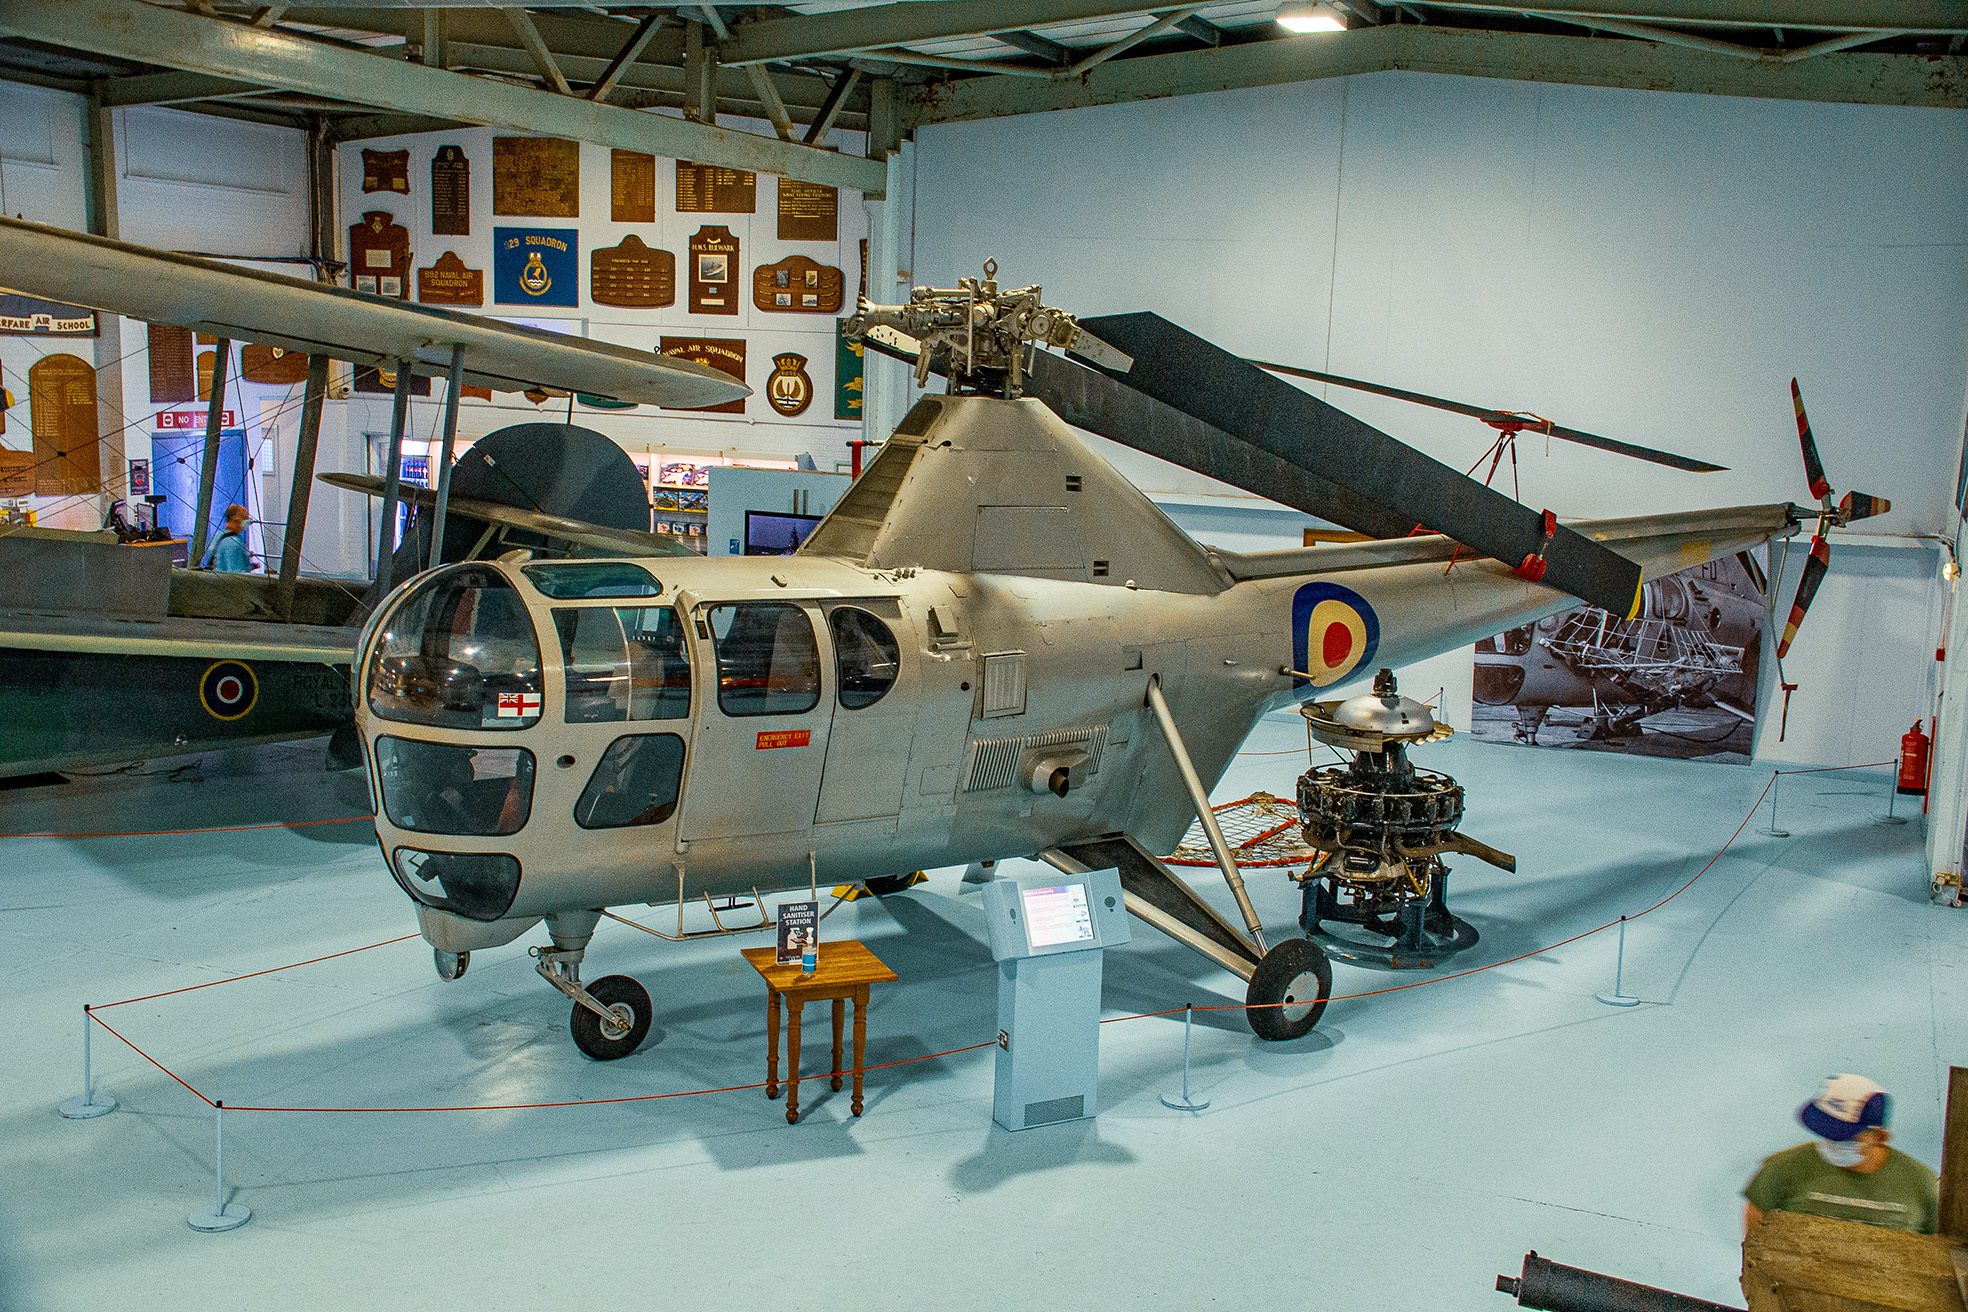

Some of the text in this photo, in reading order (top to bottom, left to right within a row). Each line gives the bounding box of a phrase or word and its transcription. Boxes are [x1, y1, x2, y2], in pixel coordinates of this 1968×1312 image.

[525, 235, 568, 252] SQUADRON
[440, 271, 460, 280] NAVAL
[462, 271, 474, 280] AIR
[430, 278, 468, 288] SQUADRON
[36, 315, 50, 325] AIR
[57, 321, 91, 330] SCHOOL
[687, 344, 701, 353] AIR
[704, 345, 744, 364] SQUADRON
[178, 415, 190, 424] NO
[293, 675, 338, 690] ROYAL
[794, 731, 810, 740] EXIT
[789, 904, 808, 912] HAND
[782, 911, 815, 920] SANITISER
[785, 918, 812, 926] STATION
